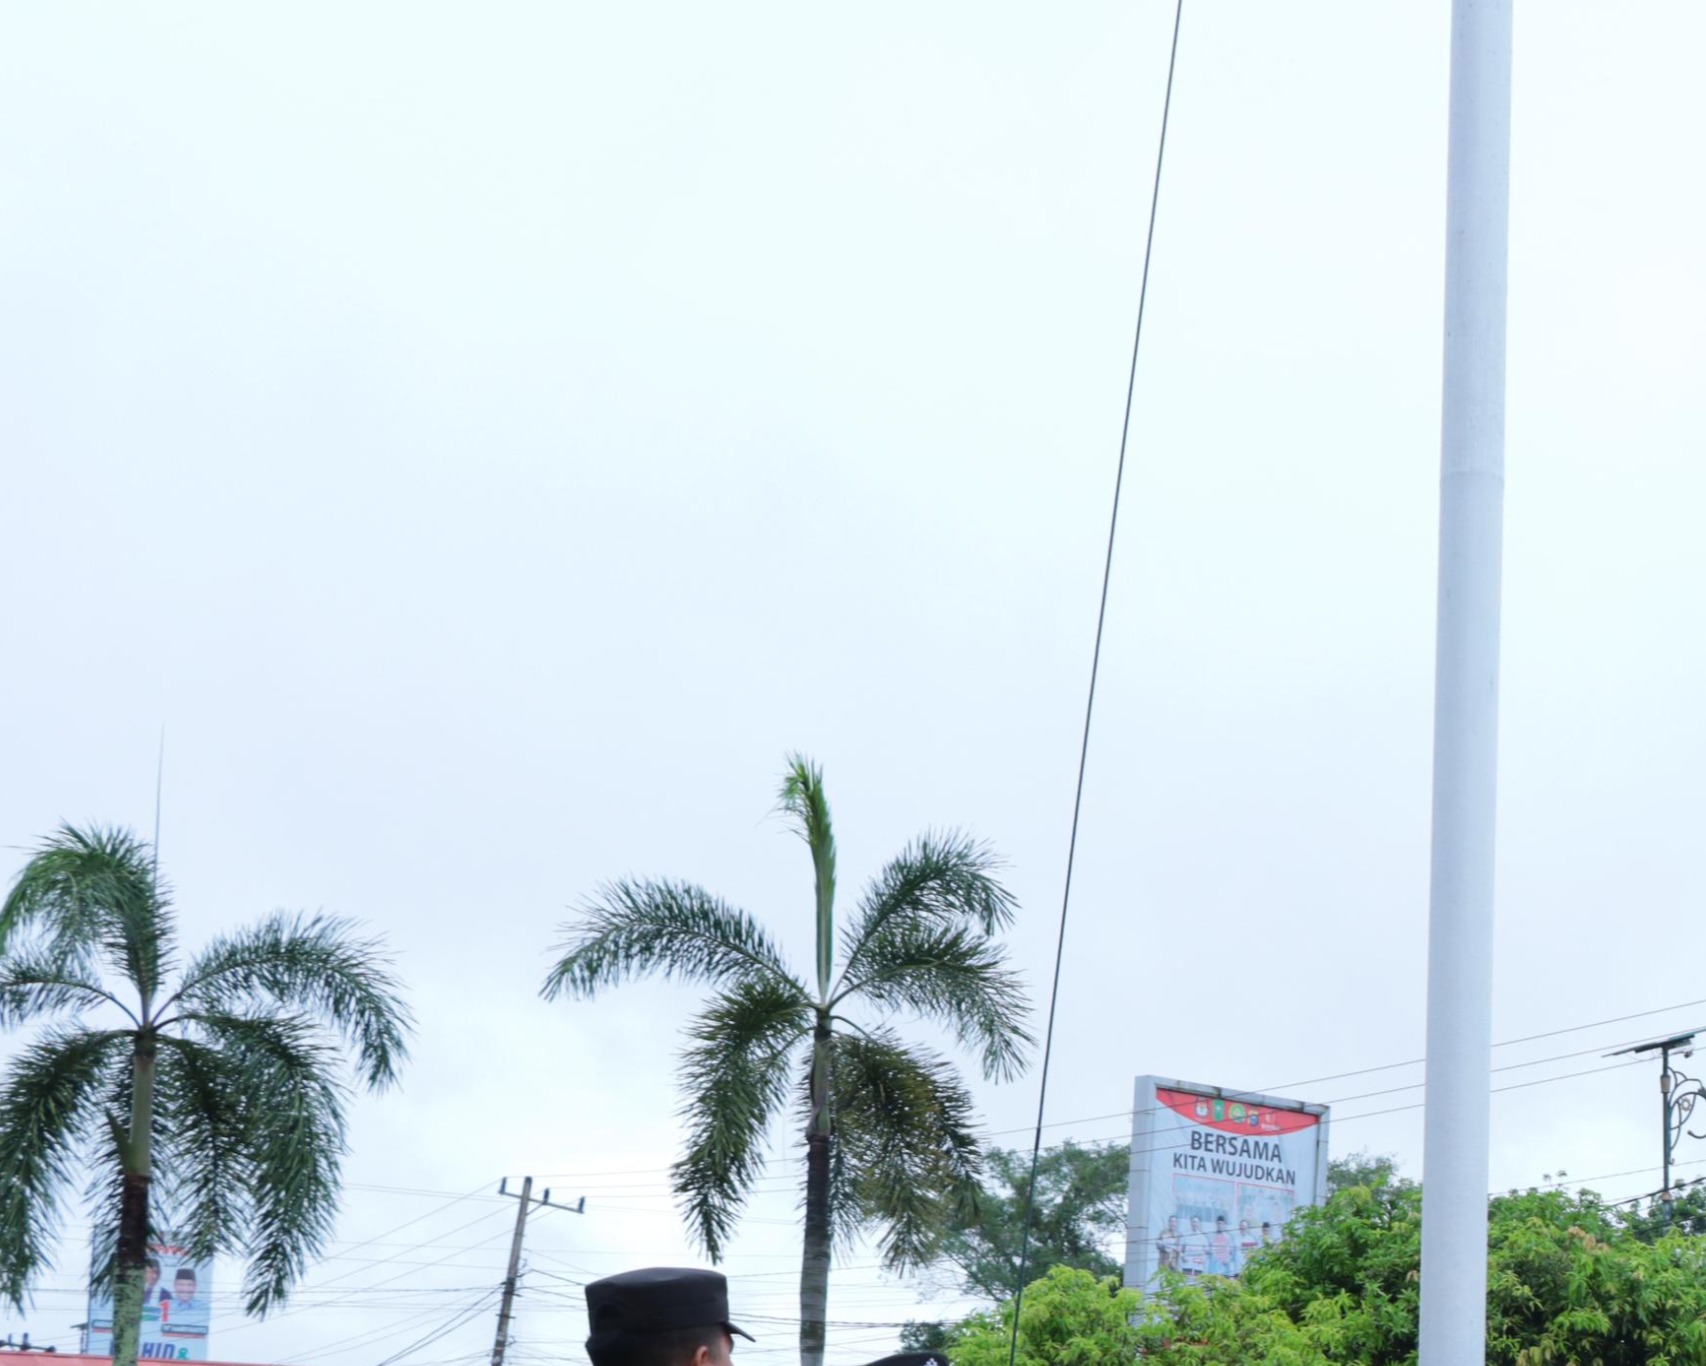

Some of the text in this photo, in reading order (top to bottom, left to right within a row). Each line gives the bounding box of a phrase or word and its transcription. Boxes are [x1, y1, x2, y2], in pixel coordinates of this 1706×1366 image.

[1191, 1130, 1282, 1163] BERSAMA
[1173, 1152, 1296, 1186] KITA WUJUDKAN
